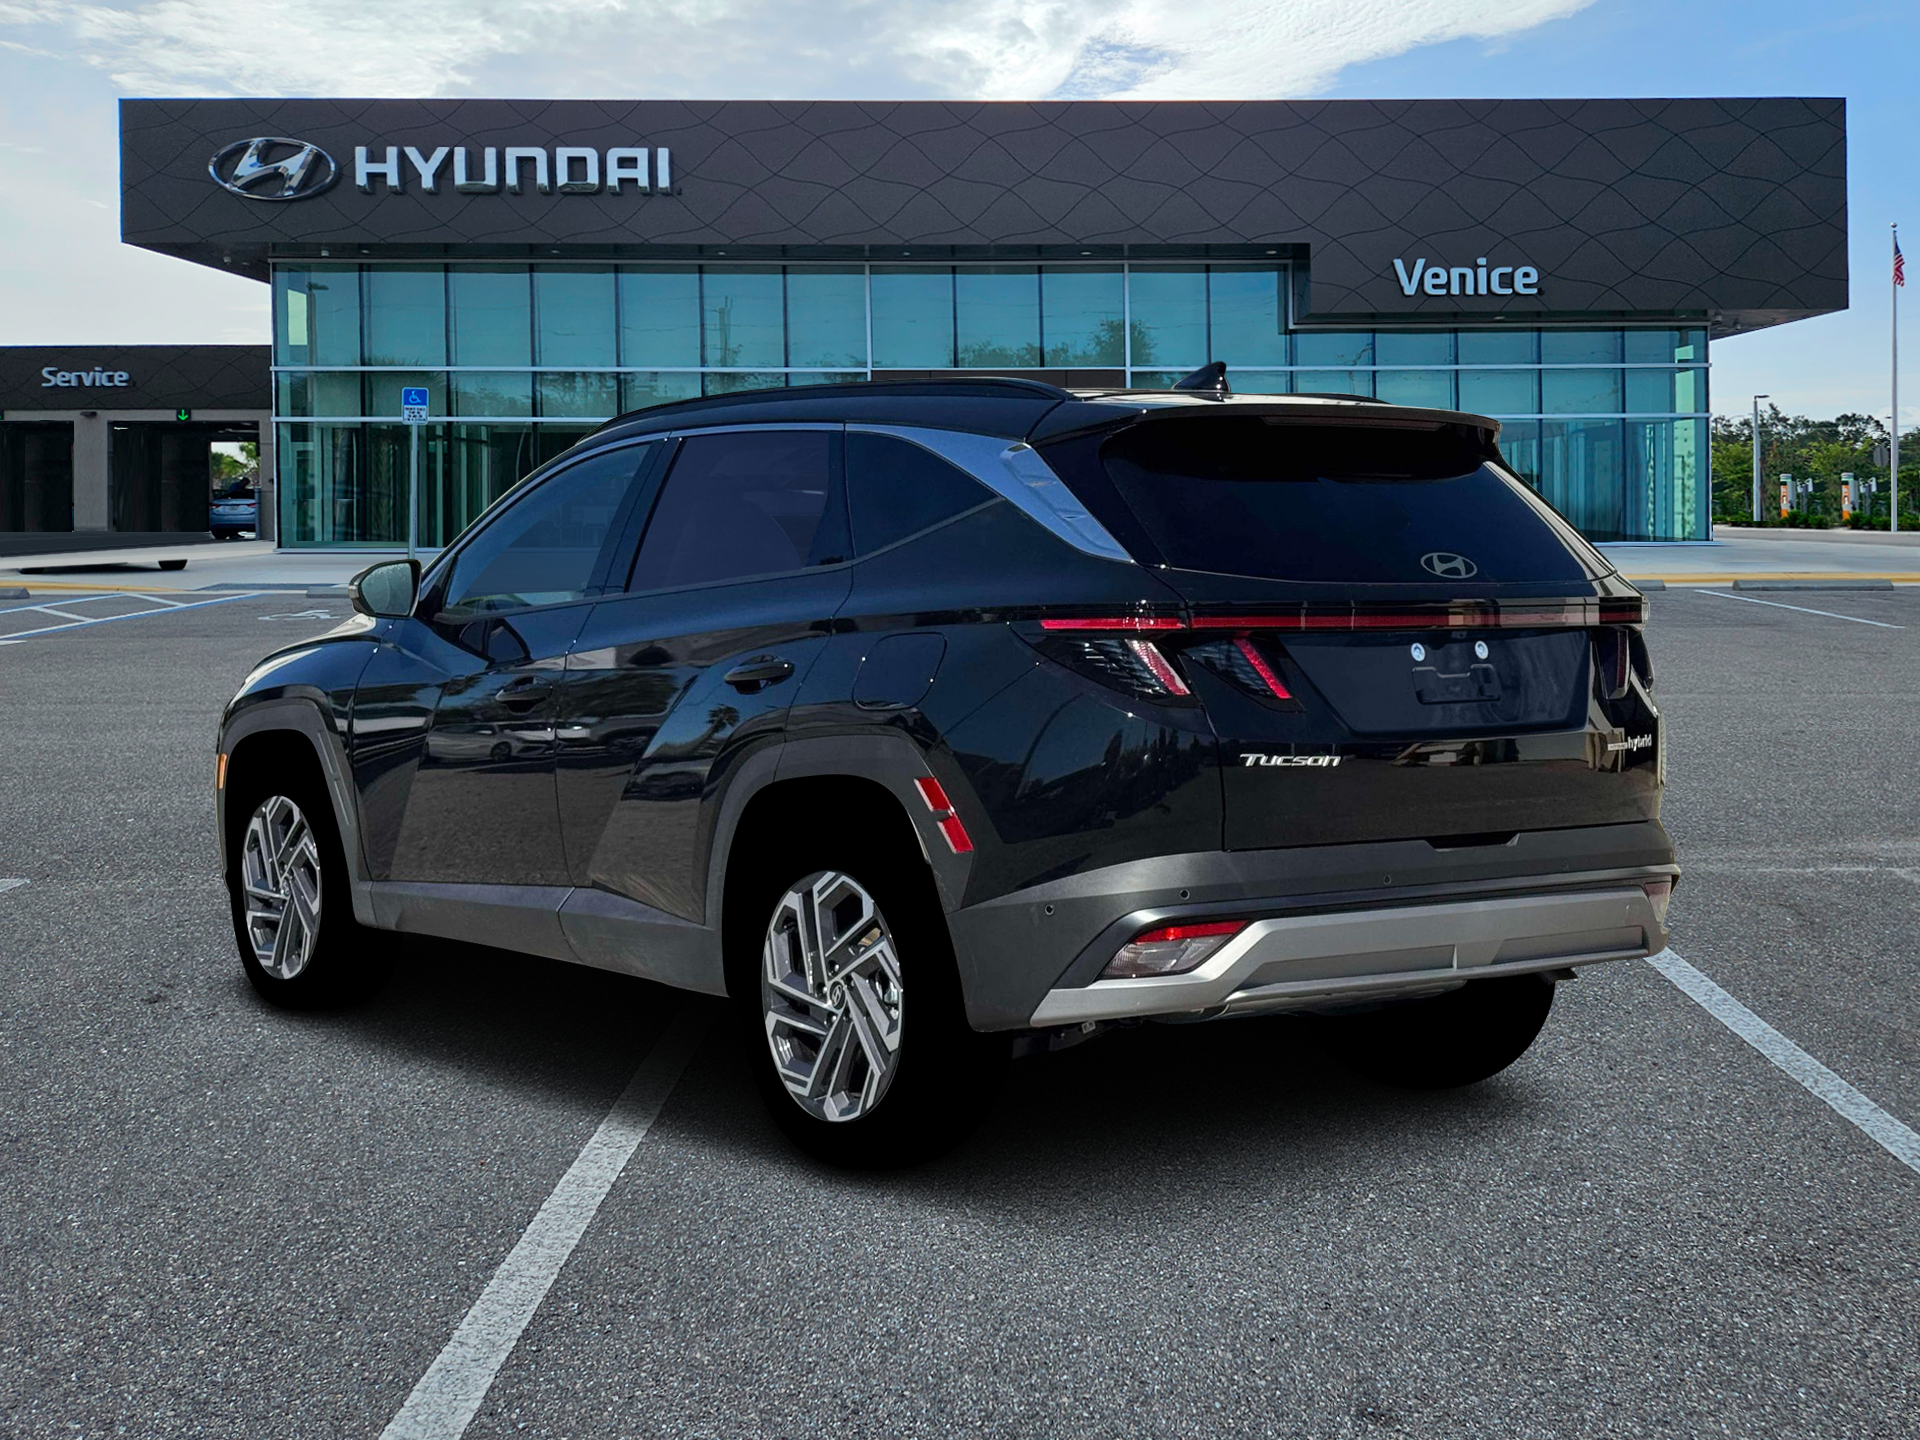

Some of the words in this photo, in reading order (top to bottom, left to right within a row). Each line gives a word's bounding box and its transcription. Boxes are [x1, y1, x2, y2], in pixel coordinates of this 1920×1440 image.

[354, 146, 670, 195] HYUNDAI
[1392, 256, 1539, 296] Venice
[41, 366, 130, 387] Service
[1627, 733, 1652, 752] hybrid
[1240, 753, 1341, 767] Tucson
